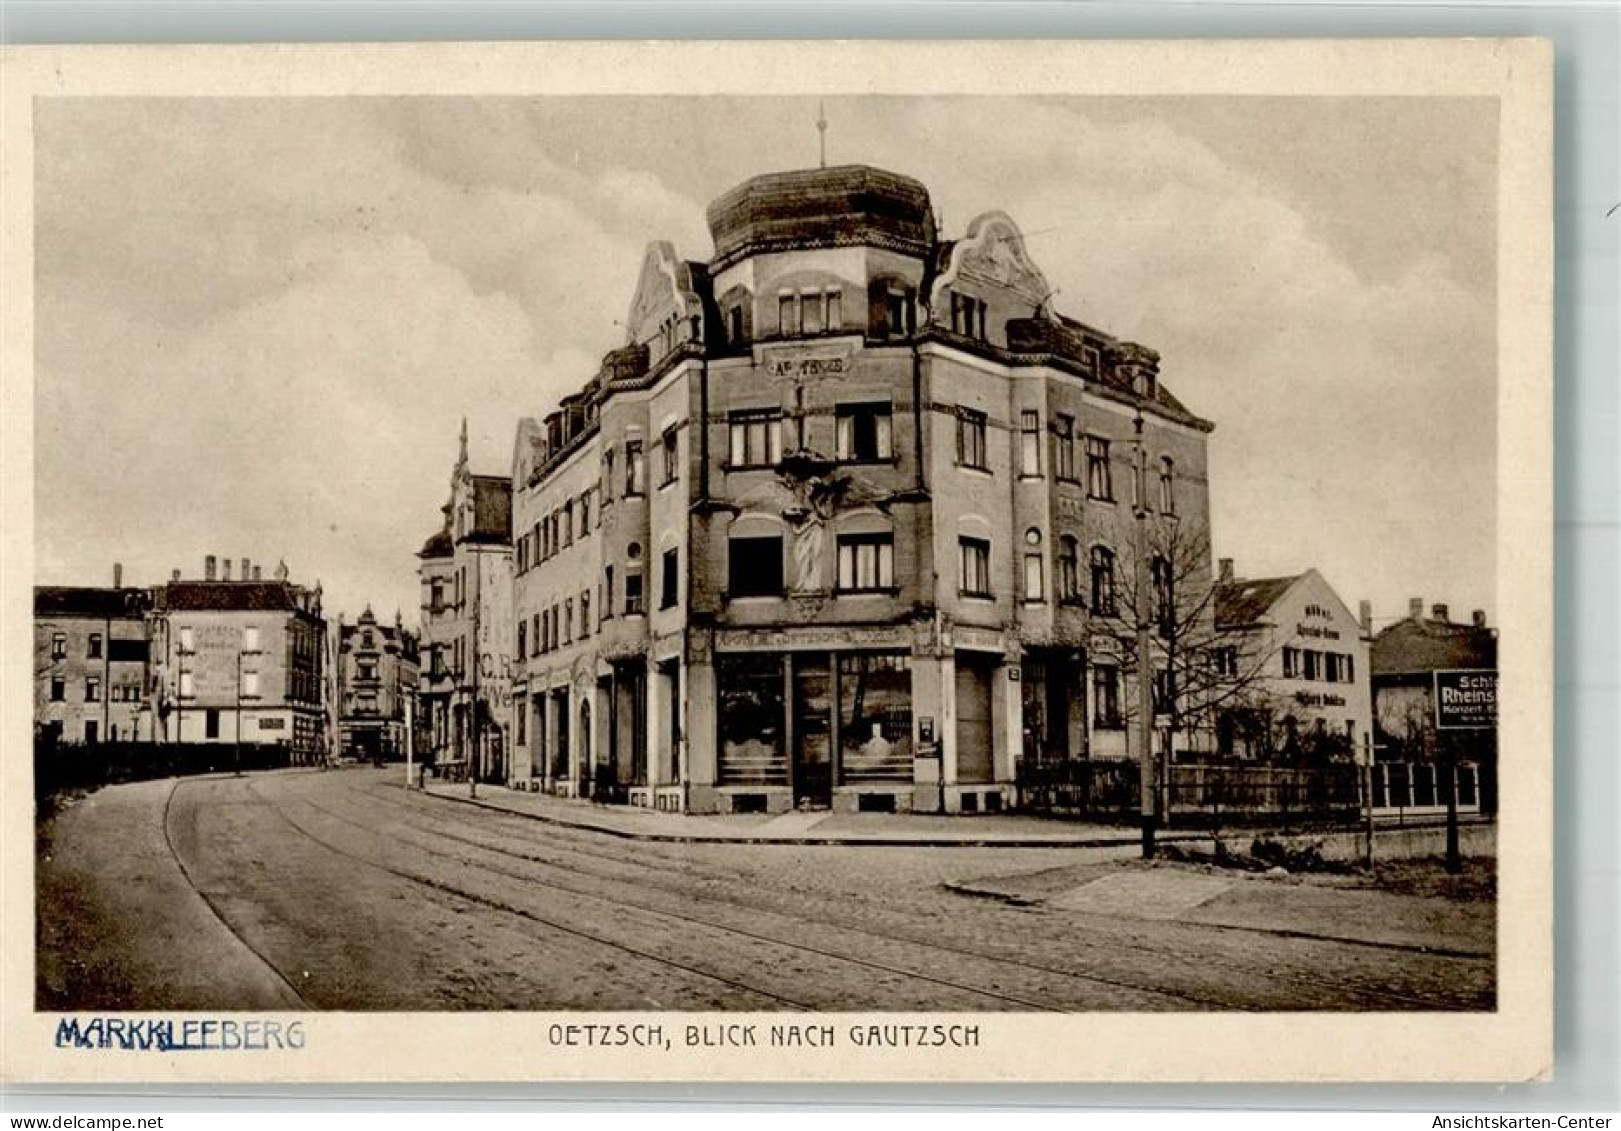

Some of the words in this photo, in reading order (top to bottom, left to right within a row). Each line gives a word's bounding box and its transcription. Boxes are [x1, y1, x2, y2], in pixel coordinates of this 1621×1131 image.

[549, 1023, 671, 1050] OETZSCH,
[686, 1025, 756, 1047] BLICK
[771, 1025, 834, 1047] NACH
[849, 1025, 979, 1048] GAUTZSCH
